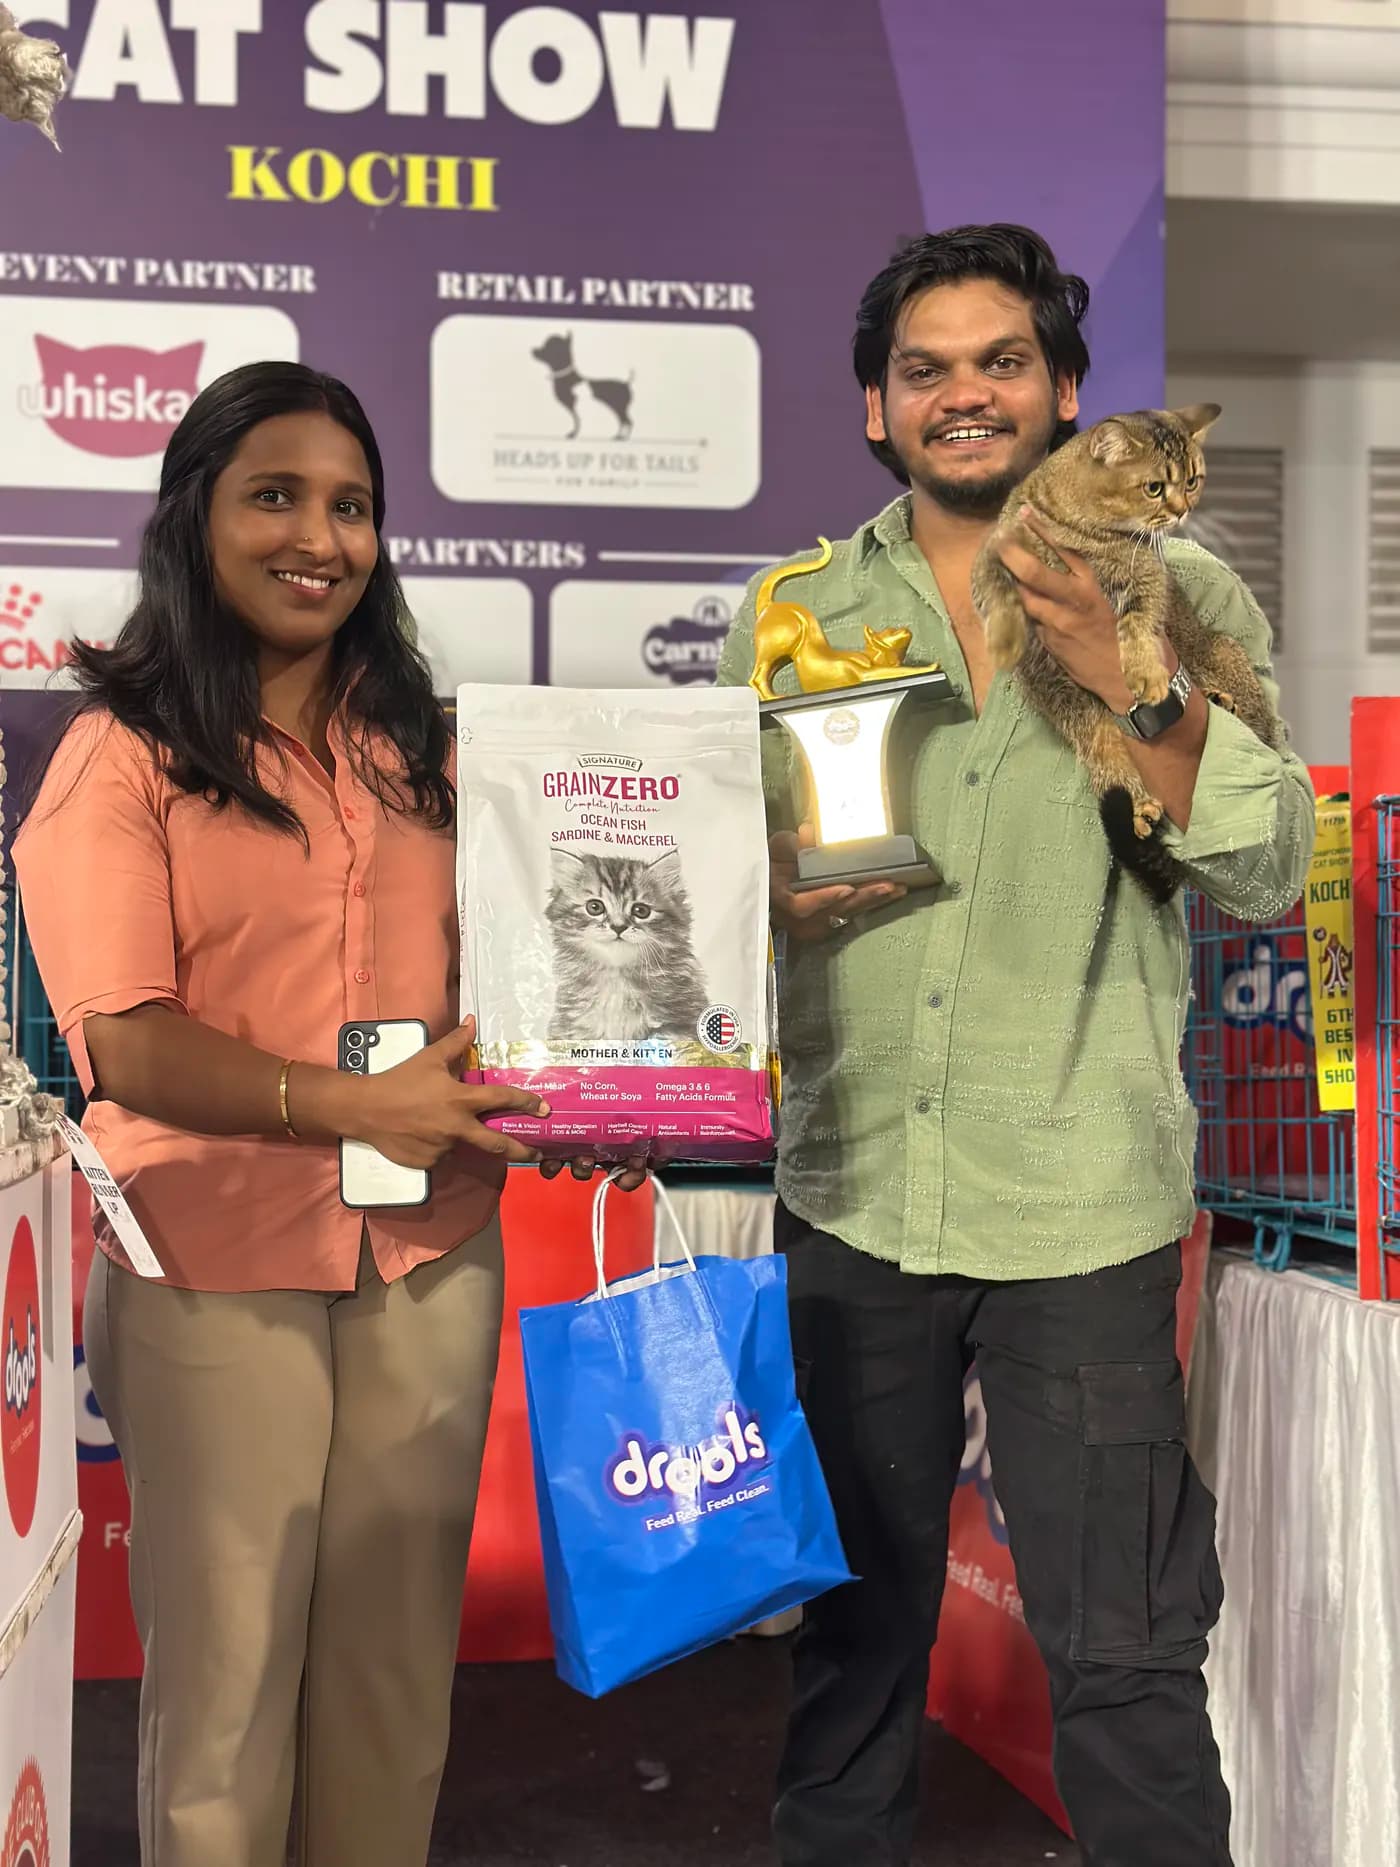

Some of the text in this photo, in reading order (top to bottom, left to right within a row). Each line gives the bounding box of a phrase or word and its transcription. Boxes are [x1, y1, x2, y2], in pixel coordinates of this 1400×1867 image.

[14, 0, 736, 131] AT SHOW
[226, 145, 500, 212] KOCHI
[0, 251, 317, 293] EVENT PARTNER
[437, 270, 755, 311] RETAIL PARTNER
[493, 448, 700, 473] HEADS UP FOR TAILS
[387, 536, 586, 569] PARTNERS
[583, 755, 637, 769] SIGNATURE
[565, 798, 661, 815] Complete Nutrition
[581, 814, 646, 831] OCEAN FISH
[551, 829, 677, 846] SARDINE & MACKEREL
[1310, 878, 1350, 903] KOCH
[1222, 945, 1313, 1034] dr
[1327, 1008, 1353, 1024] 6TH
[571, 1048, 618, 1058] MOTHER
[621, 1048, 630, 1058] &
[1337, 1049, 1353, 1062] IN
[1325, 1069, 1355, 1084] SHO
[581, 1082, 593, 1090] No
[656, 1082, 711, 1092] Omega 3 & 6
[581, 1092, 608, 1101] Wheat
[621, 1092, 642, 1102] Soya
[656, 1092, 736, 1102] Fatty Acids Formula
[83, 1166, 110, 1181] KITTEN
[91, 1183, 121, 1198] RUNNER
[105, 1201, 119, 1214] UP
[5, 1312, 36, 1410] drools
[613, 1411, 766, 1497] drools
[646, 1514, 675, 1531] Feed
[707, 1494, 734, 1512] Feed
[947, 1551, 973, 1587] eed
